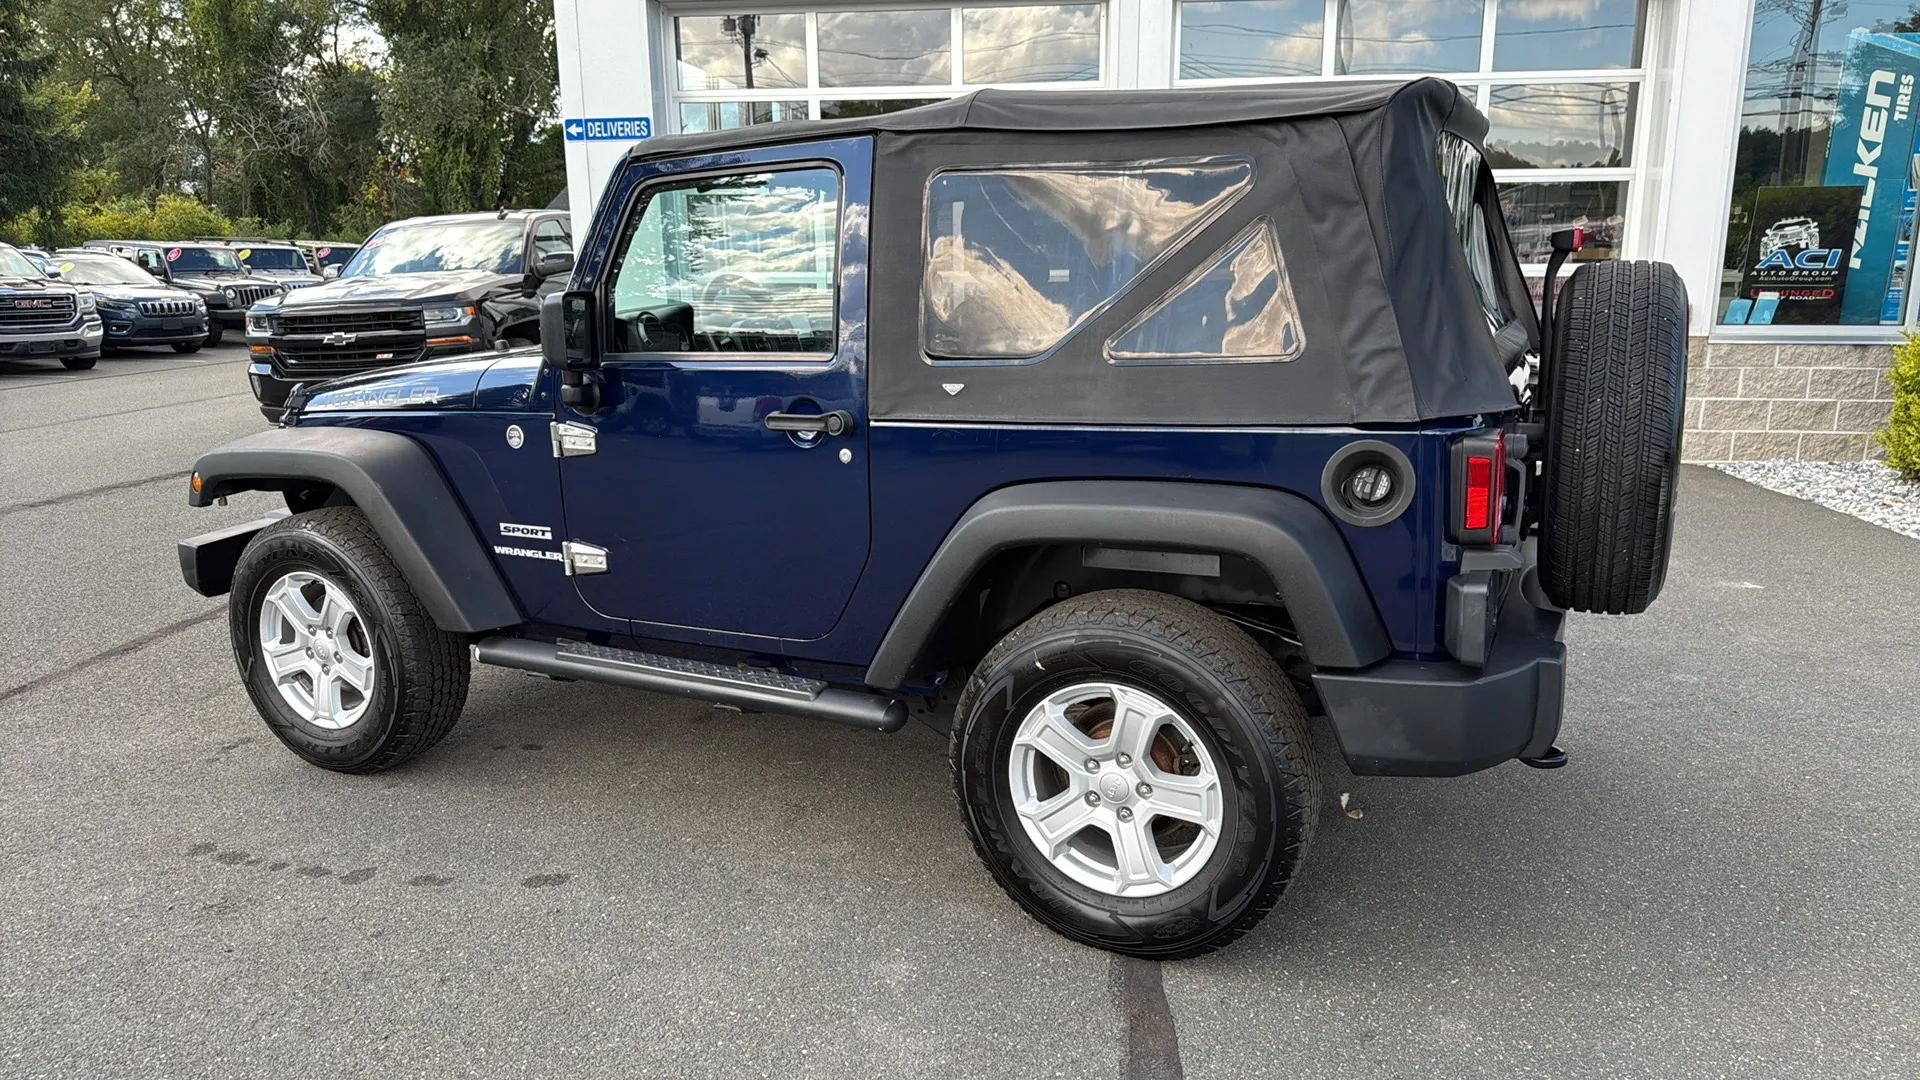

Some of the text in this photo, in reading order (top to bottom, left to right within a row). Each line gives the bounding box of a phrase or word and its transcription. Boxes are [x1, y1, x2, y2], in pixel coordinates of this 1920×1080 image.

[1894, 74, 1914, 121] TIRES
[588, 121, 648, 136] DELIVERIES
[1754, 249, 1842, 268] ACI
[15, 299, 52, 308] GMC
[502, 525, 548, 537] SPORT
[493, 545, 564, 562] WRANGLER
